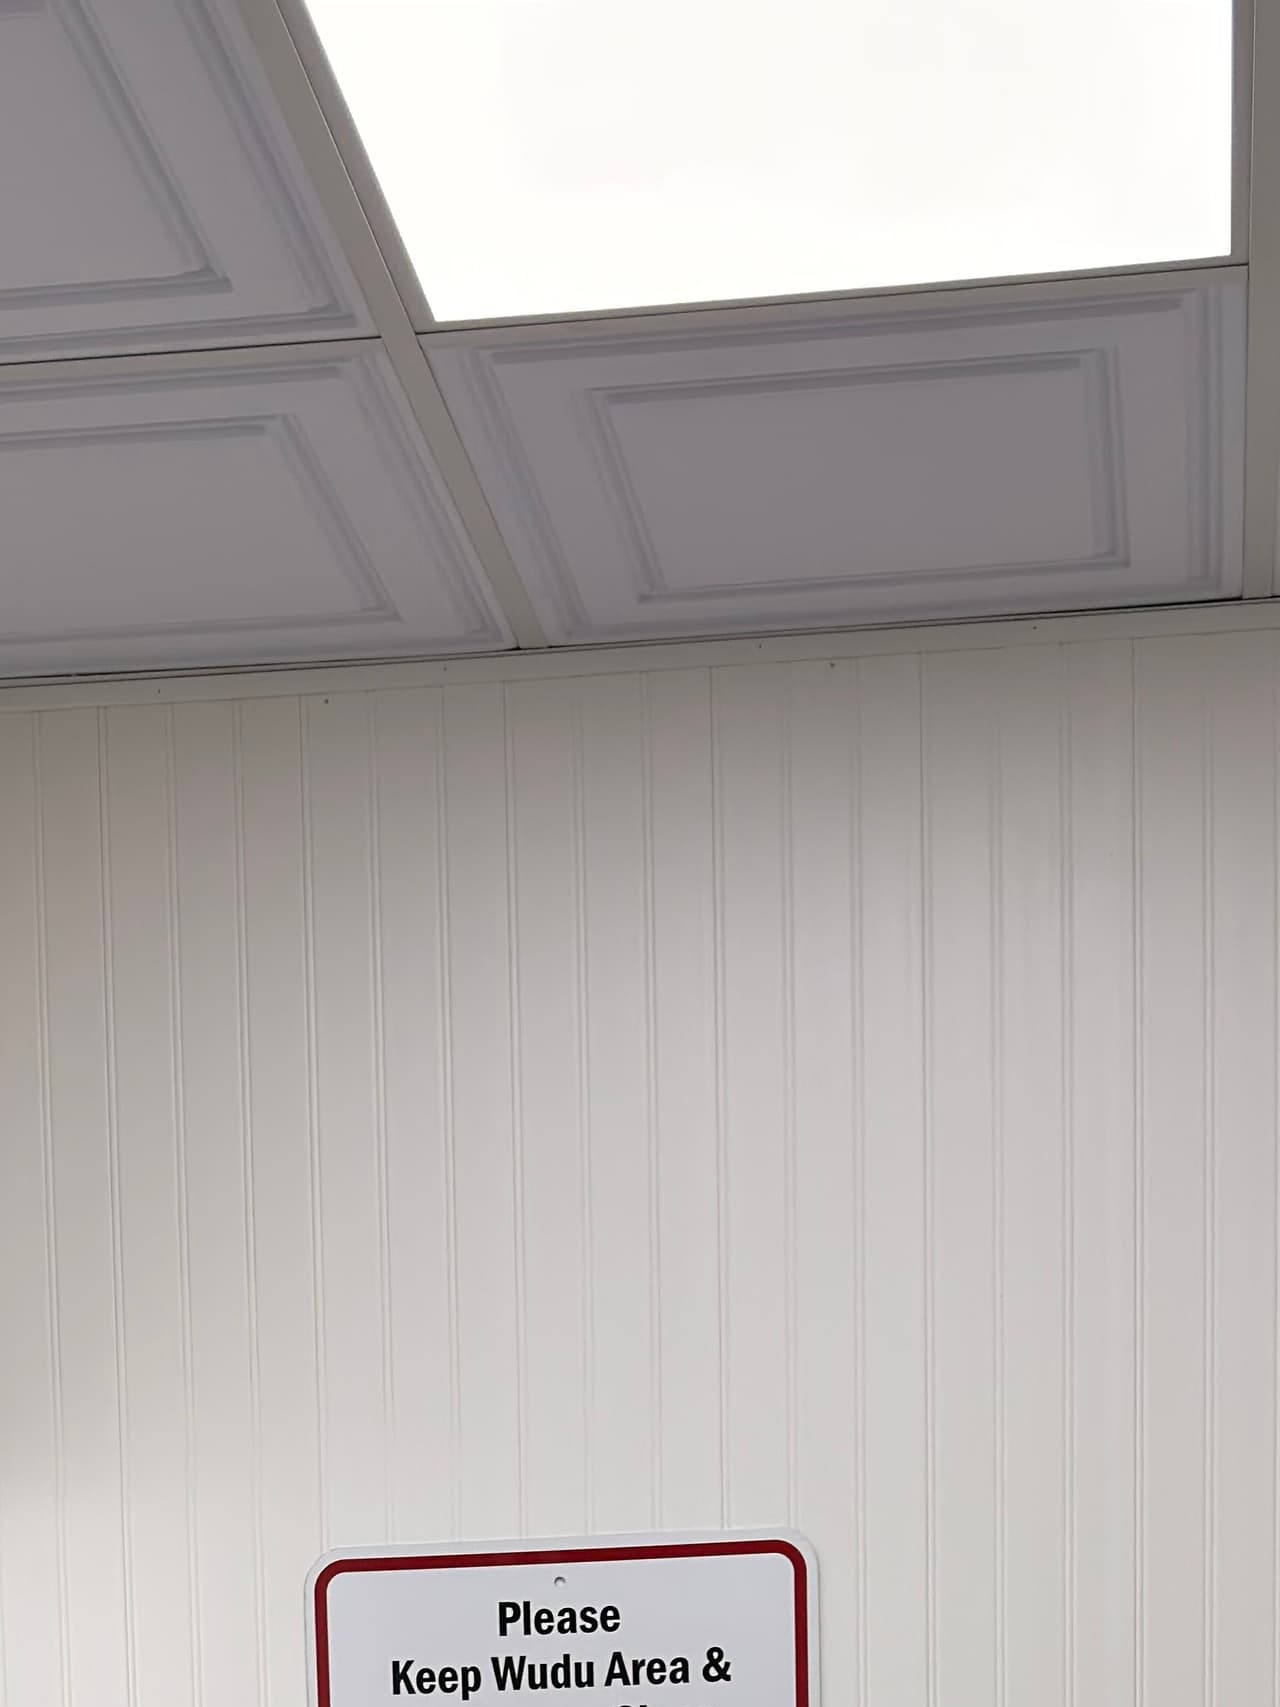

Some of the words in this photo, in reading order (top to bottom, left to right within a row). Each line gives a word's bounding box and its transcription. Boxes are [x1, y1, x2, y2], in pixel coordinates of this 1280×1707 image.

[498, 1600, 621, 1637] Please
[391, 1659, 482, 1701] Keep
[490, 1653, 595, 1692] Wudu
[604, 1651, 690, 1687] Area
[702, 1646, 732, 1683] &
